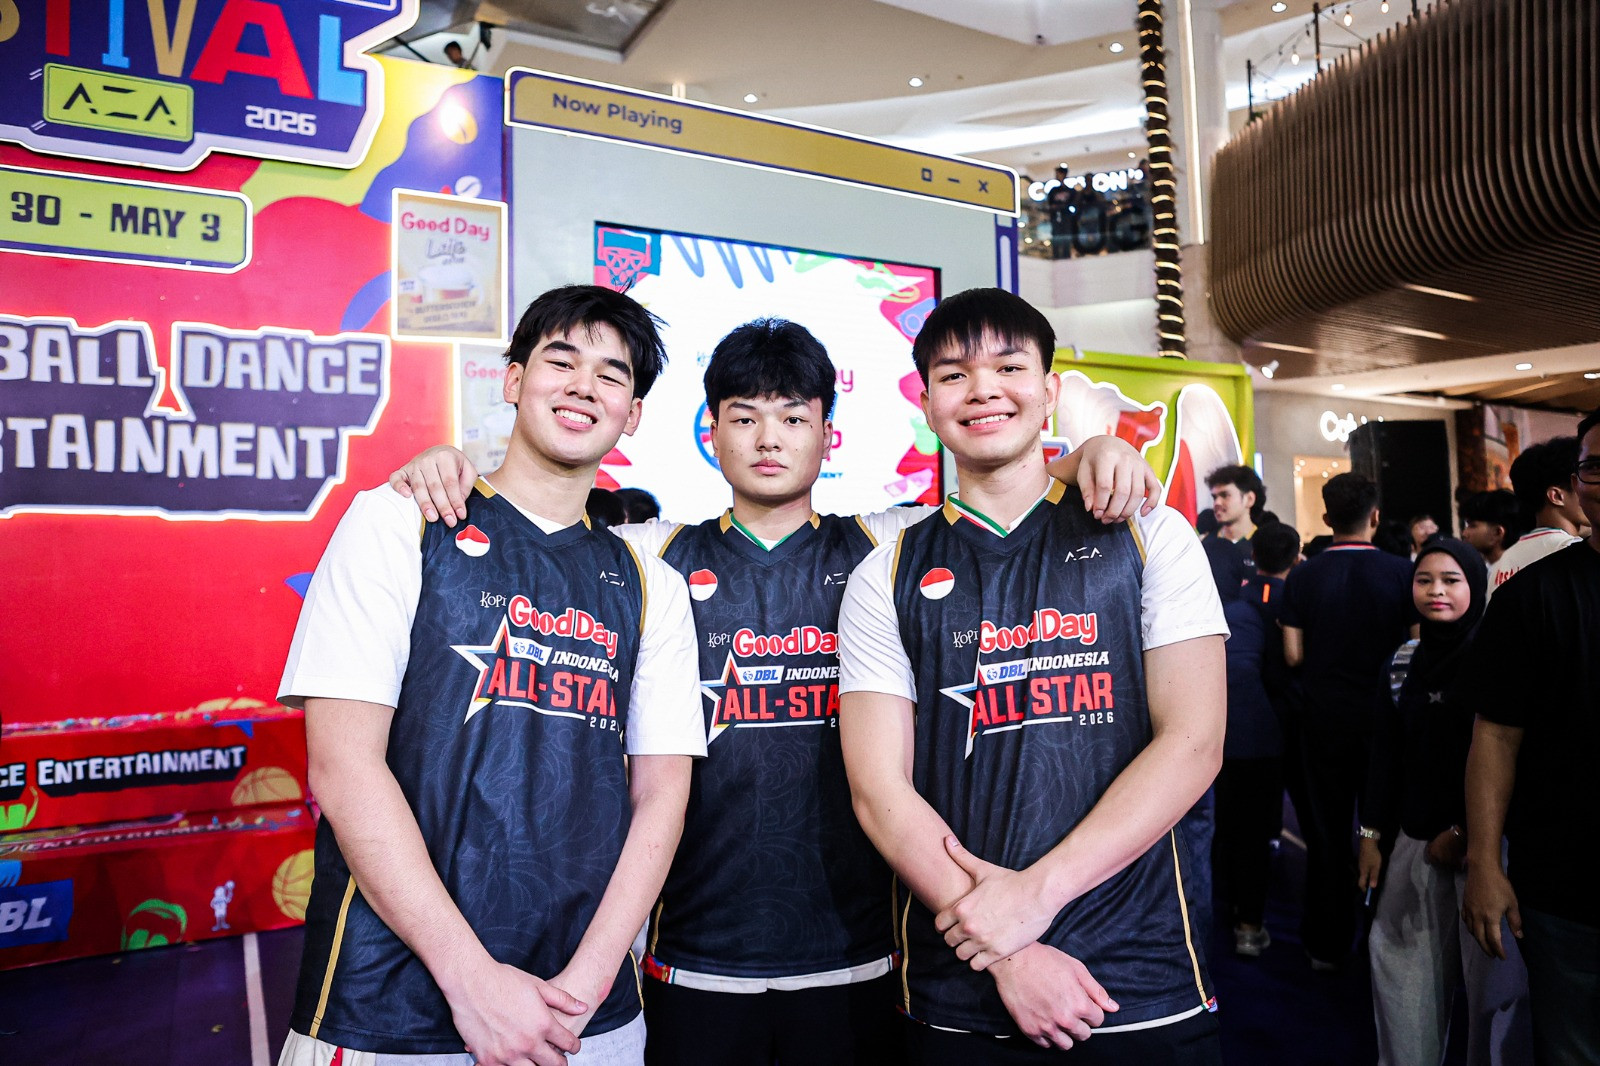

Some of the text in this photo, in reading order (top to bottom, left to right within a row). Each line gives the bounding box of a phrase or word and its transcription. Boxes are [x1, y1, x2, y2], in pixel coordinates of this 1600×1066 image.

[245, 105, 317, 136] 2026
[552, 93, 682, 134] Now Playing
[11, 191, 61, 226] 30
[110, 203, 187, 241] MAY
[201, 213, 220, 242] 3
[401, 212, 490, 242] Good Day
[0, 325, 379, 396] BALL DANCE
[0, 414, 336, 480] TAINMENT
[526, 643, 544, 661] DBL
[998, 651, 1110, 679] DBL INDONESIA
[754, 669, 779, 681] DBL
[723, 684, 840, 721] ALL-STA
[1079, 711, 1114, 726] 2026
[590, 716, 620, 732] 202
[37, 745, 247, 786] ENTERTAINMENT
[0, 896, 52, 933] BL
